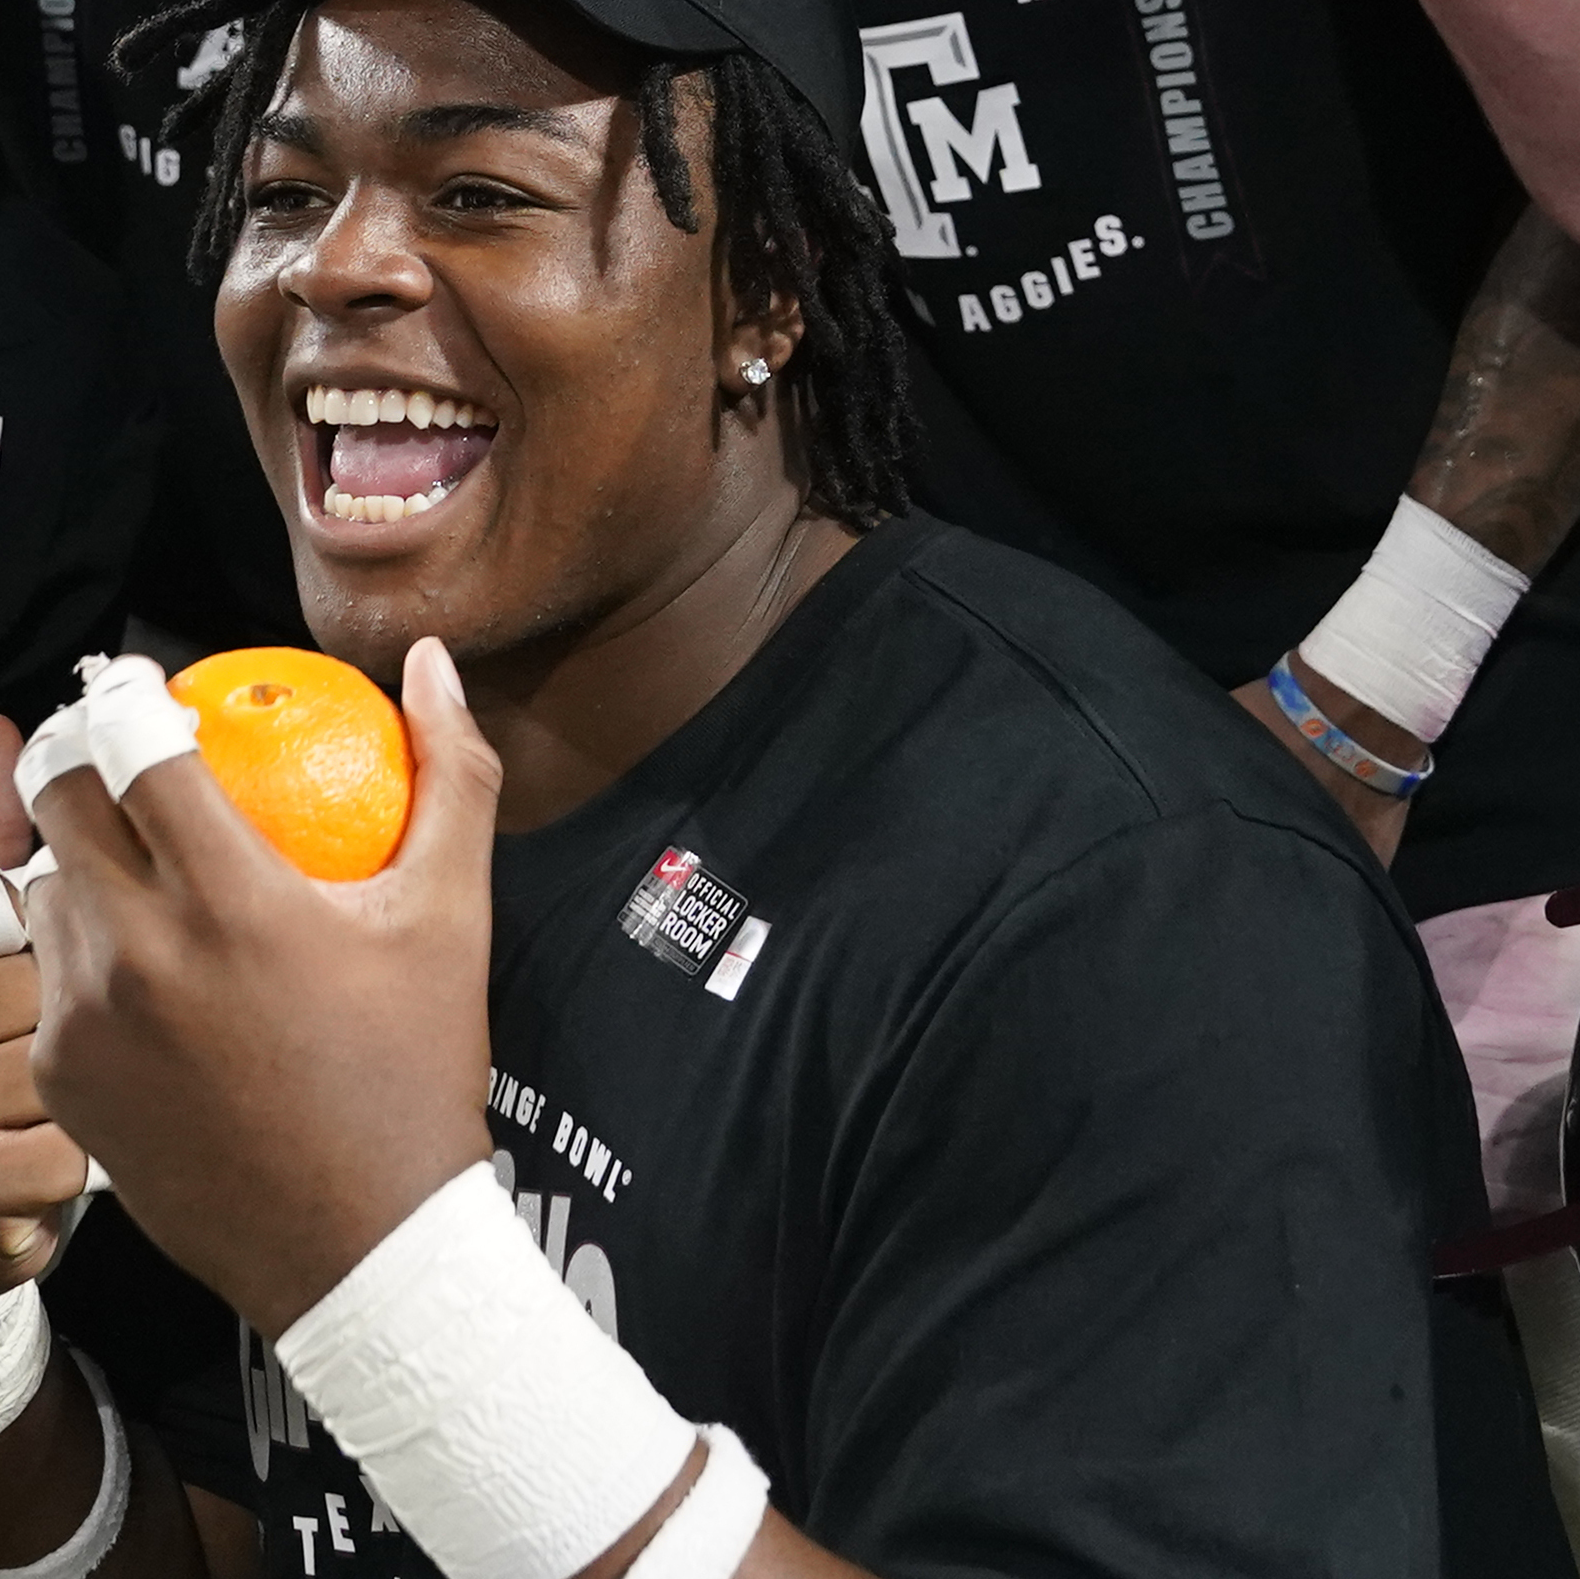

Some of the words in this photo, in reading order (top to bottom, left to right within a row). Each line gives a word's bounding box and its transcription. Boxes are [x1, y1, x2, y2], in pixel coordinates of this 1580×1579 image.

[673, 889, 728, 940] LOCKER
[687, 872, 741, 920] OFFICIAL
[659, 911, 714, 960] ROOM
